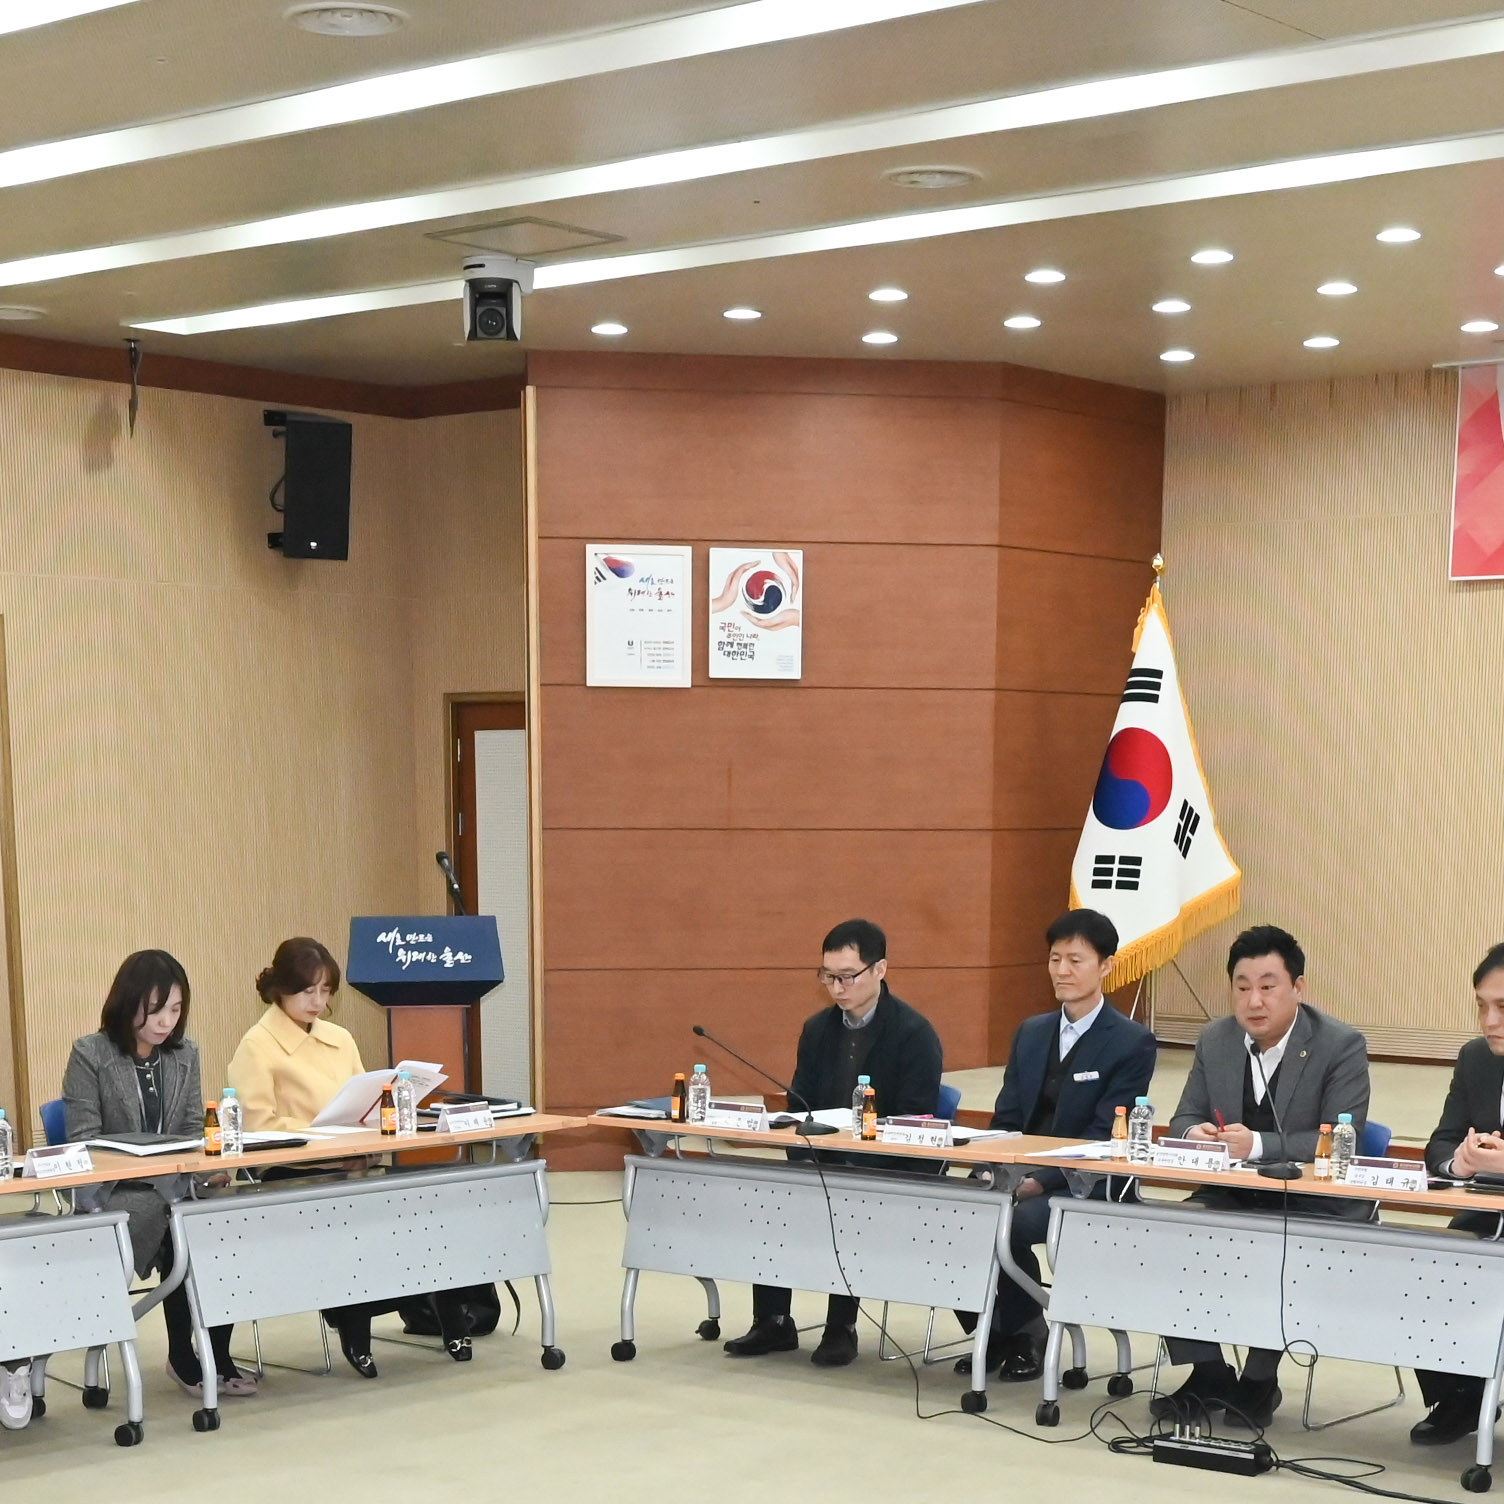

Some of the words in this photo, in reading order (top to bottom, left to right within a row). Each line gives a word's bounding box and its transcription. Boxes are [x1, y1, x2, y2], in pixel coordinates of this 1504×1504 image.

[719, 622, 741, 632] 국민이
[717, 641, 734, 651] 함께
[723, 650, 755, 661] 대한민국
